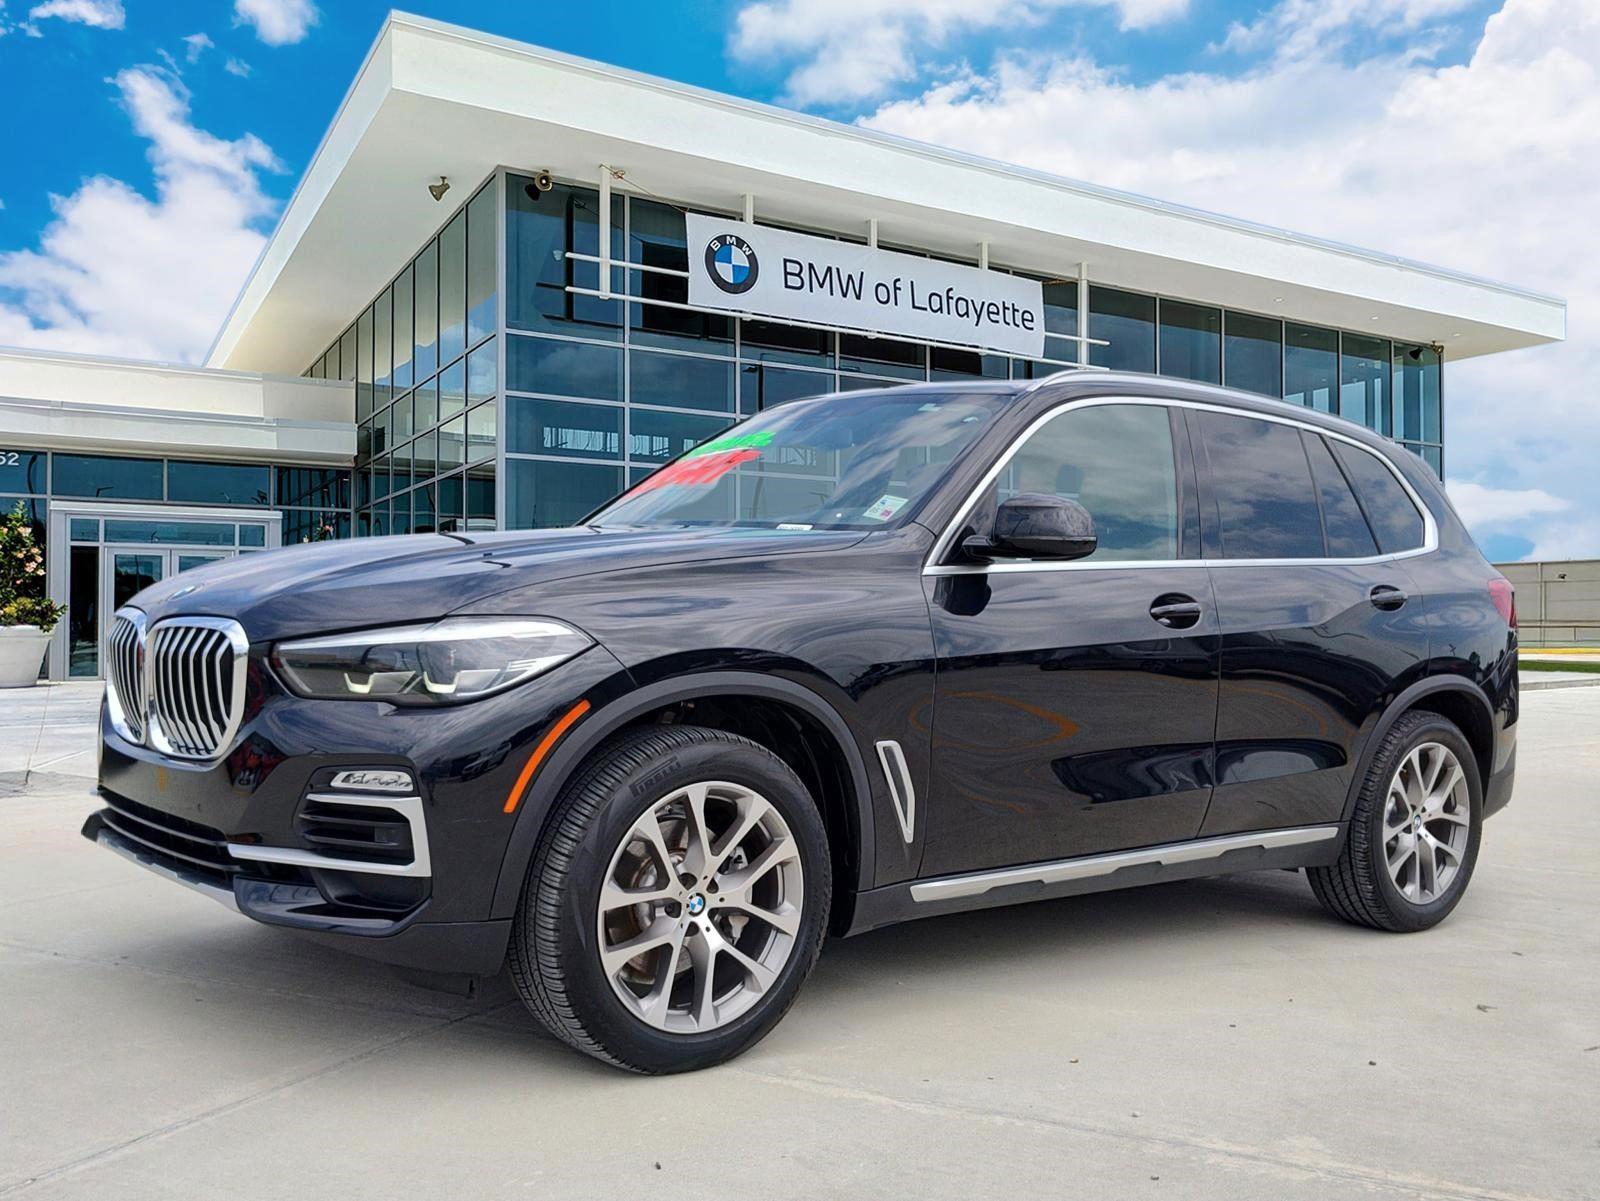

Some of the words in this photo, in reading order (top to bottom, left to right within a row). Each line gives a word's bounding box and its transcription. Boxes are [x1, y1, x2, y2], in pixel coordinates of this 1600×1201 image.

[709, 235, 753, 257] BMW
[782, 257, 865, 301] BMW
[874, 277, 902, 307] of
[910, 281, 1035, 331] Lafayette
